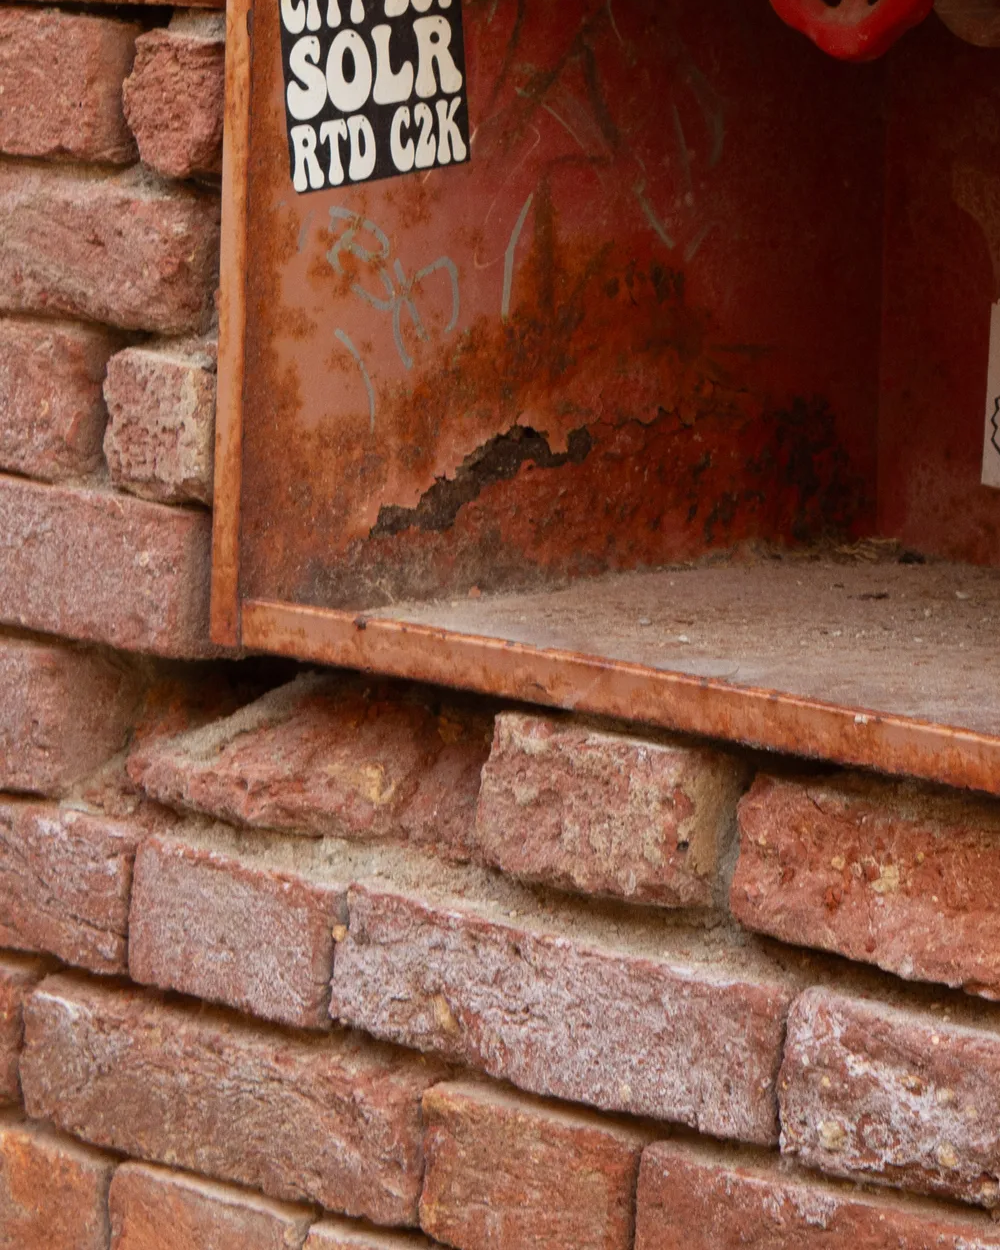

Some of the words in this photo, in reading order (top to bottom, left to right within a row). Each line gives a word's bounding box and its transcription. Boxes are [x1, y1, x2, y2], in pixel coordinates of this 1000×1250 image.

[286, 15, 463, 121] SOLR
[291, 115, 376, 193] RTD
[390, 97, 467, 173] C2K
